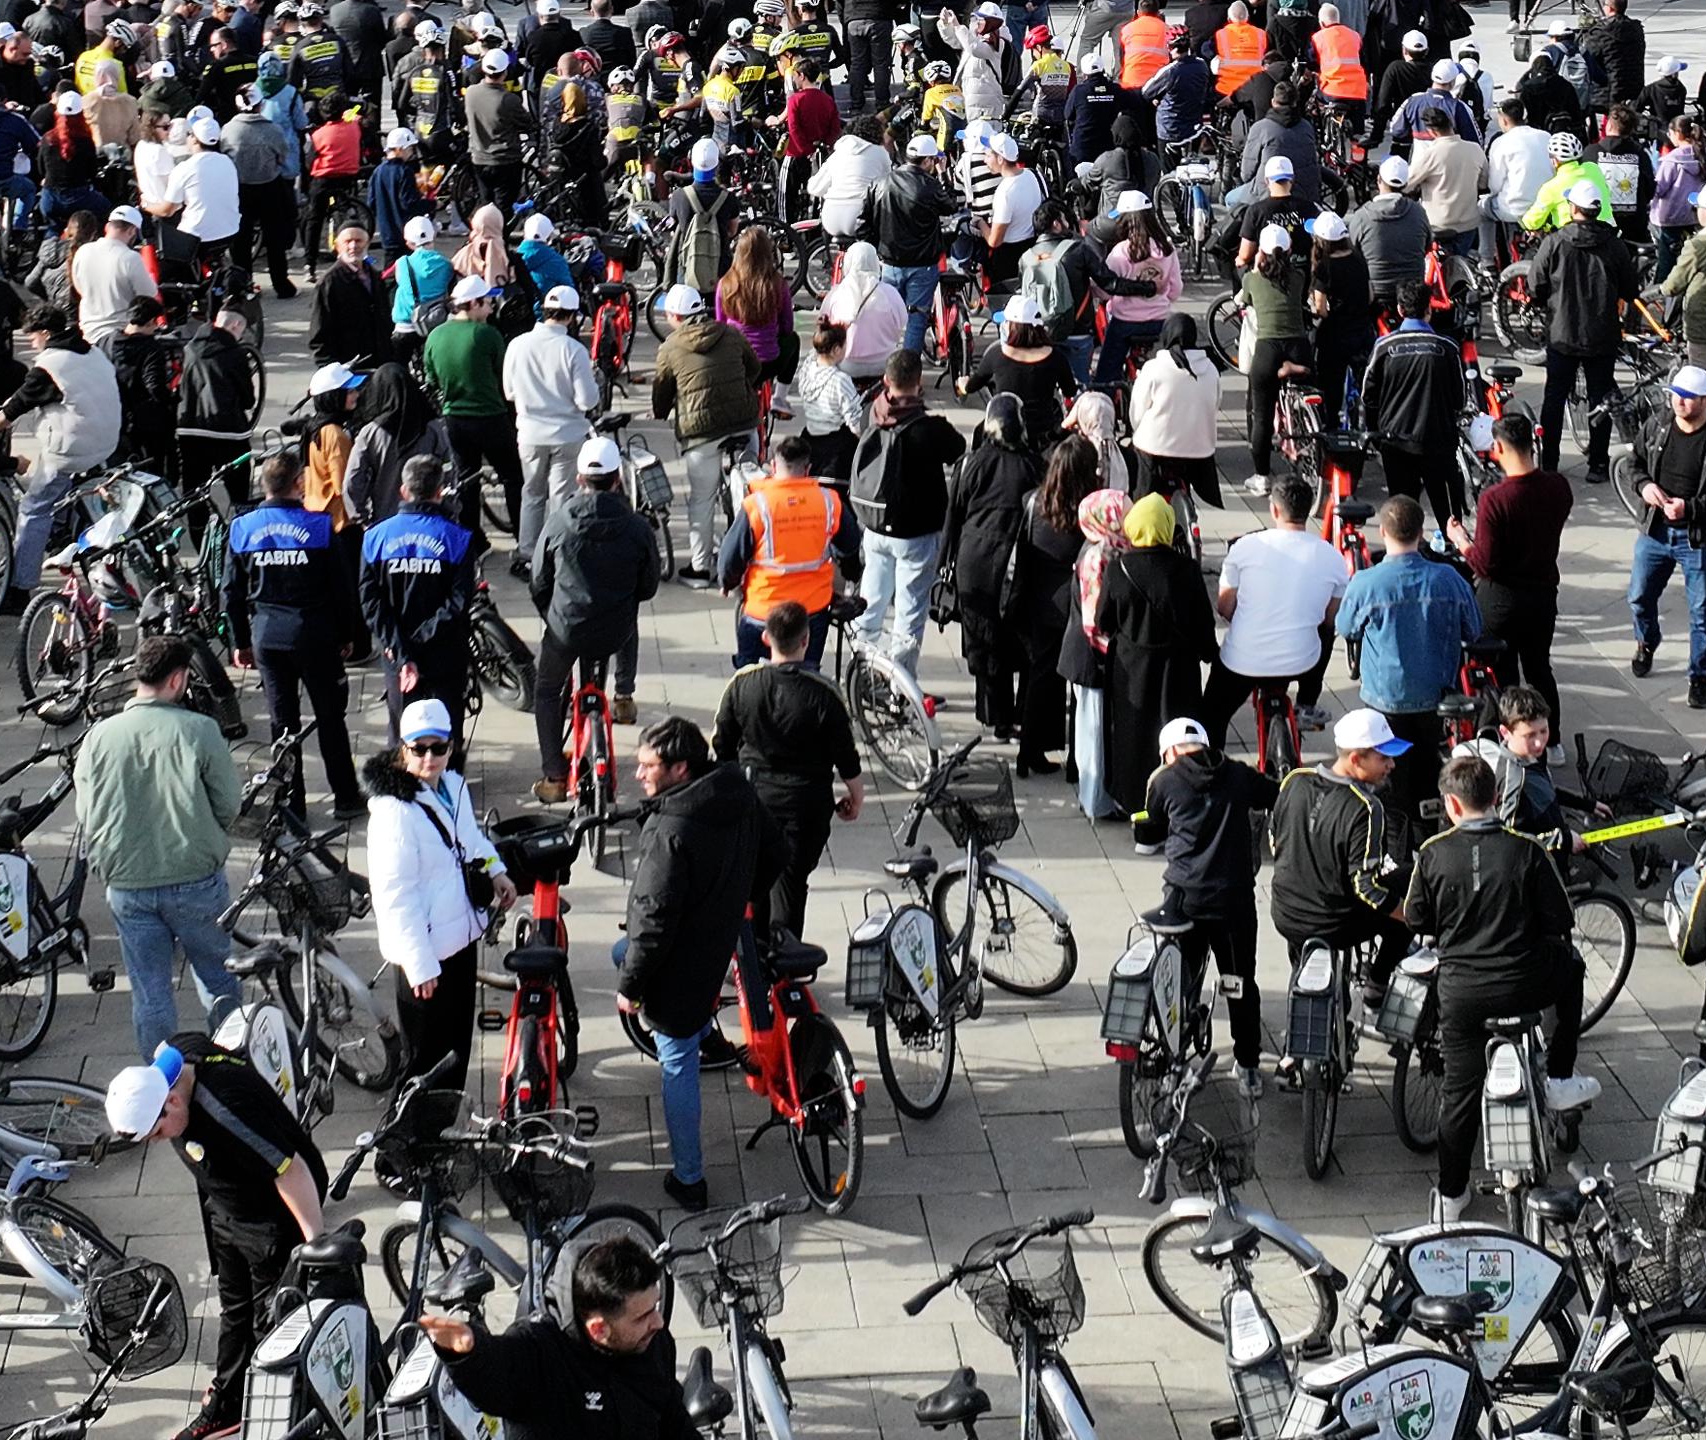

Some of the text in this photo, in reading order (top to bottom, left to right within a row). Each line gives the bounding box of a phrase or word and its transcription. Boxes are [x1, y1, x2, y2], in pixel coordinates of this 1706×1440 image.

[249, 522, 311, 544] BÜYÜKŞEHİR
[386, 531, 445, 555] BÜYÜKŞEHİR
[253, 550, 308, 566] ZABITA
[388, 558, 442, 574] ZABITA
[1418, 1250, 1444, 1260] AAR
[1478, 1254, 1501, 1263] AAR
[1400, 1378, 1419, 1393] AAR
[1350, 1391, 1373, 1410] AAR
